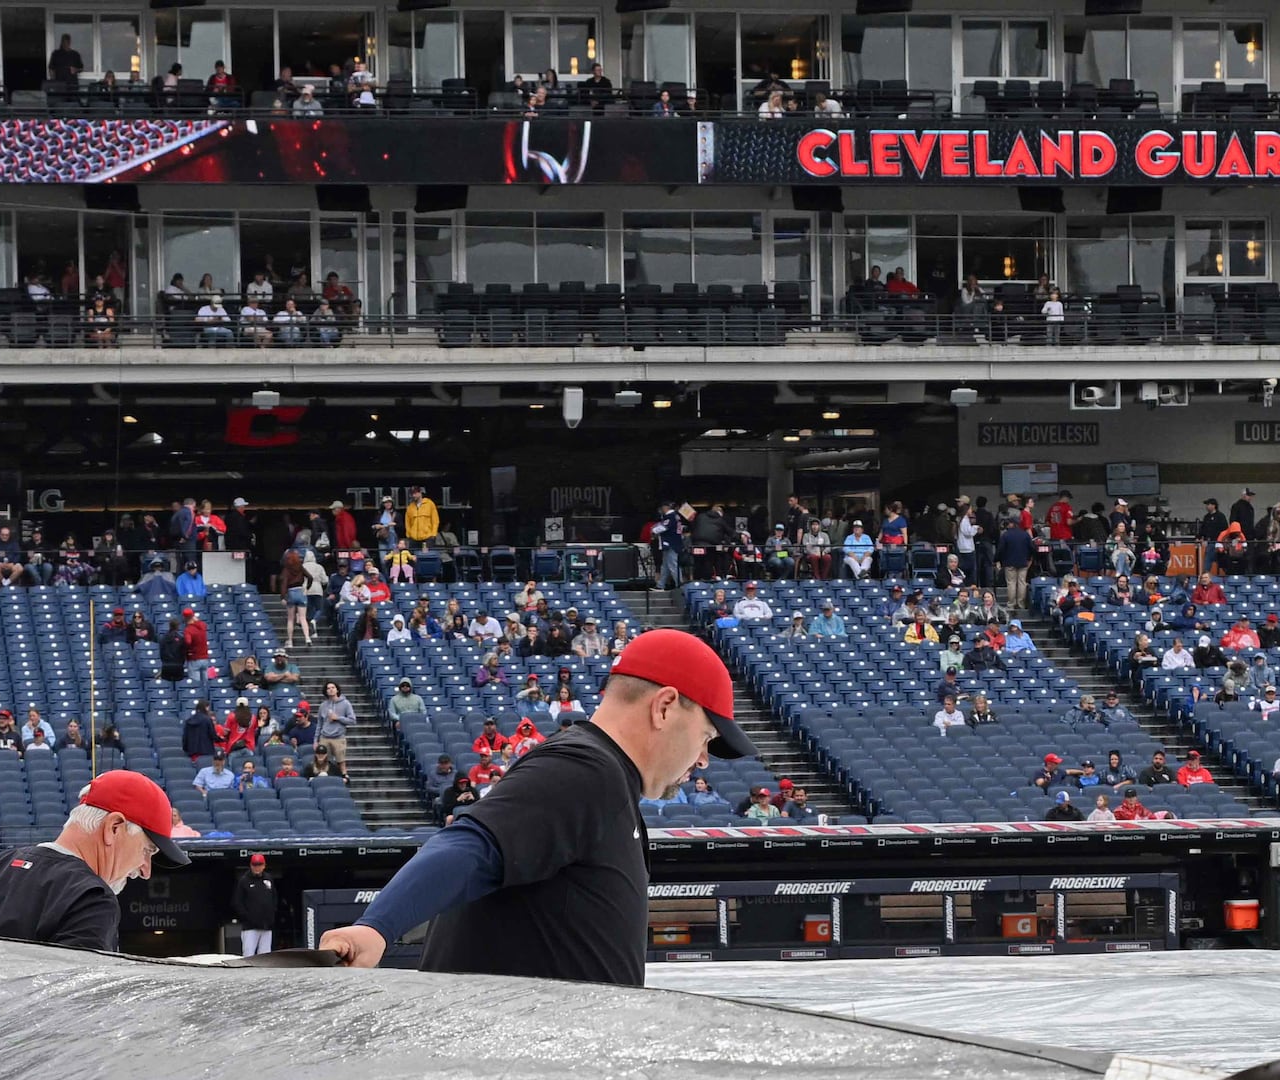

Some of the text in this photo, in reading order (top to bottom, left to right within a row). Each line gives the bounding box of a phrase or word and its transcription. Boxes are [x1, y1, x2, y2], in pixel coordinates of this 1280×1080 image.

[797, 128, 1117, 179] CLEVELAND
[225, 406, 309, 447] C
[1243, 423, 1270, 442] LOU
[982, 424, 1096, 444] STAN COVELESKI
[1166, 554, 1195, 569] NE
[774, 881, 850, 895] PROGRESSIVE
[910, 880, 987, 893] PROGRESSIVE
[1050, 877, 1127, 890] PROGRESSIVE
[648, 884, 716, 897] ROGRESSIVE
[129, 901, 190, 913] Cleveland
[142, 915, 177, 927] Clinic
[1017, 919, 1030, 931] G
[817, 924, 828, 935] G
